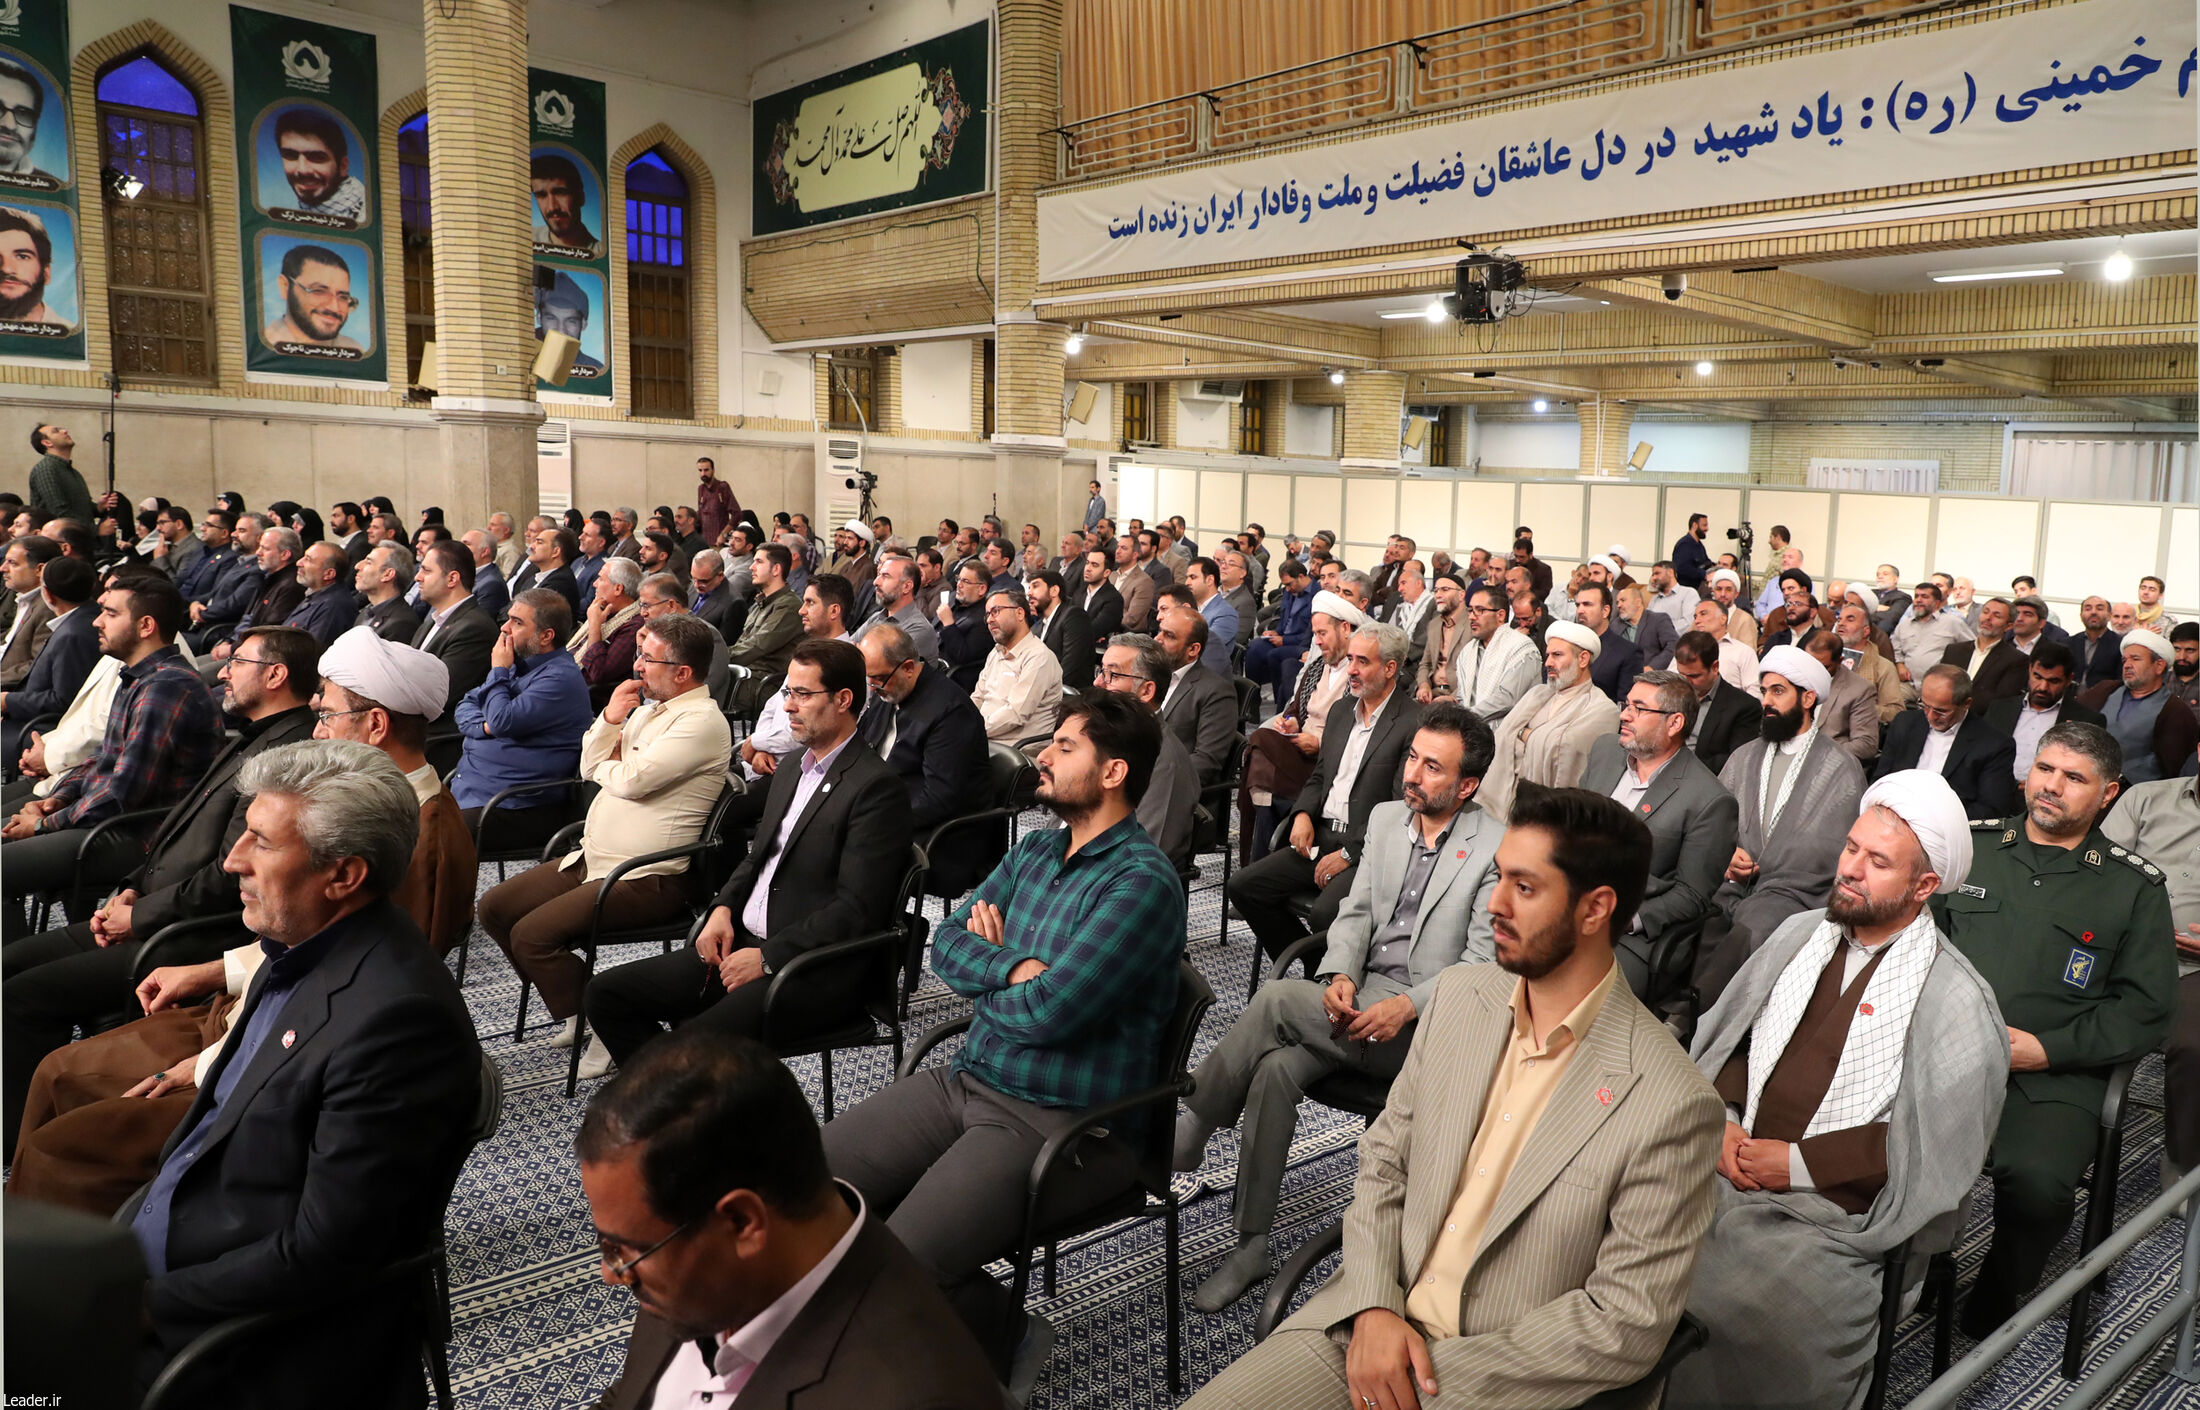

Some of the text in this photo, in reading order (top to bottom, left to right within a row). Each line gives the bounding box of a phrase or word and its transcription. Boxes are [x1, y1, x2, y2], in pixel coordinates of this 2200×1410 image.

[1995, 35, 2162, 124] خمینی
[1791, 91, 1843, 147] یاد
[1693, 102, 1778, 164] شهید
[1580, 129, 1627, 182] دل
[1636, 126, 1676, 175] در
[1473, 137, 1572, 198] عاشقان
[11, 175, 31, 186] شهید
[1385, 151, 1465, 206] فضیلت
[1193, 188, 1244, 235] ایران
[312, 215, 328, 225] شهید
[328, 216, 347, 228] سردار
[1108, 204, 1144, 240] است
[1148, 200, 1188, 239] زنده
[562, 247, 574, 256] شهید
[573, 249, 590, 258] سردار
[20, 323, 39, 333] شهید
[39, 324, 61, 336] سردار
[304, 346, 322, 355] حسن
[322, 347, 338, 356] شهید
[337, 348, 356, 358] سردار
[579, 366, 594, 376] سردار
